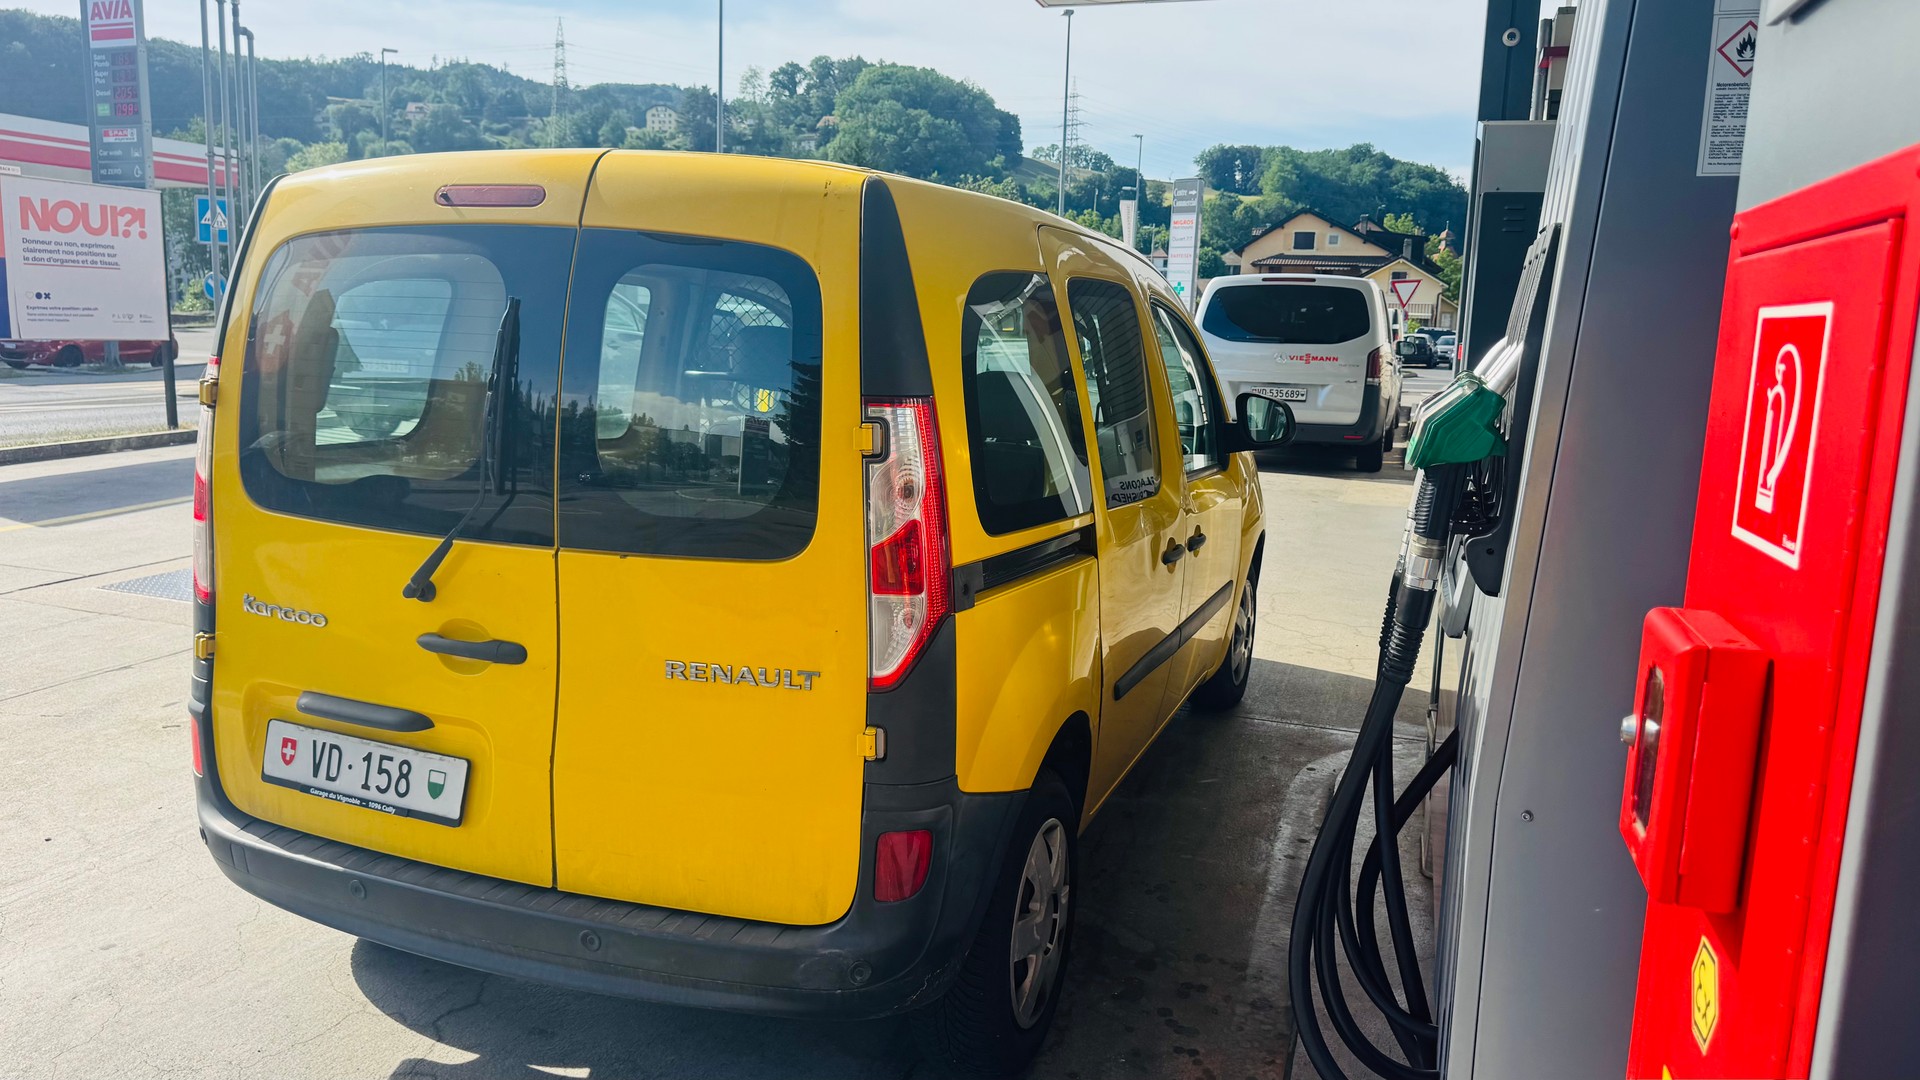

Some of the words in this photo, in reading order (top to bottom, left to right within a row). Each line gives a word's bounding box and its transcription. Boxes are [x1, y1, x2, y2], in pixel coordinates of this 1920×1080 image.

[91, 0, 133, 20] AVIA
[22, 238, 52, 246] Donneur
[80, 242, 115, 250] exprimons
[23, 247, 61, 255] clairement
[76, 249, 106, 258] positions
[47, 256, 80, 265] d'organes
[100, 259, 120, 267] tissus.
[1289, 353, 1339, 364] VIESSMANN
[243, 592, 328, 628] Kangoo
[665, 659, 821, 691] RENAULT
[310, 788, 328, 798] Garage
[337, 794, 360, 805] Vignoble
[368, 801, 381, 810] 1096
[382, 804, 396, 814] Cully
